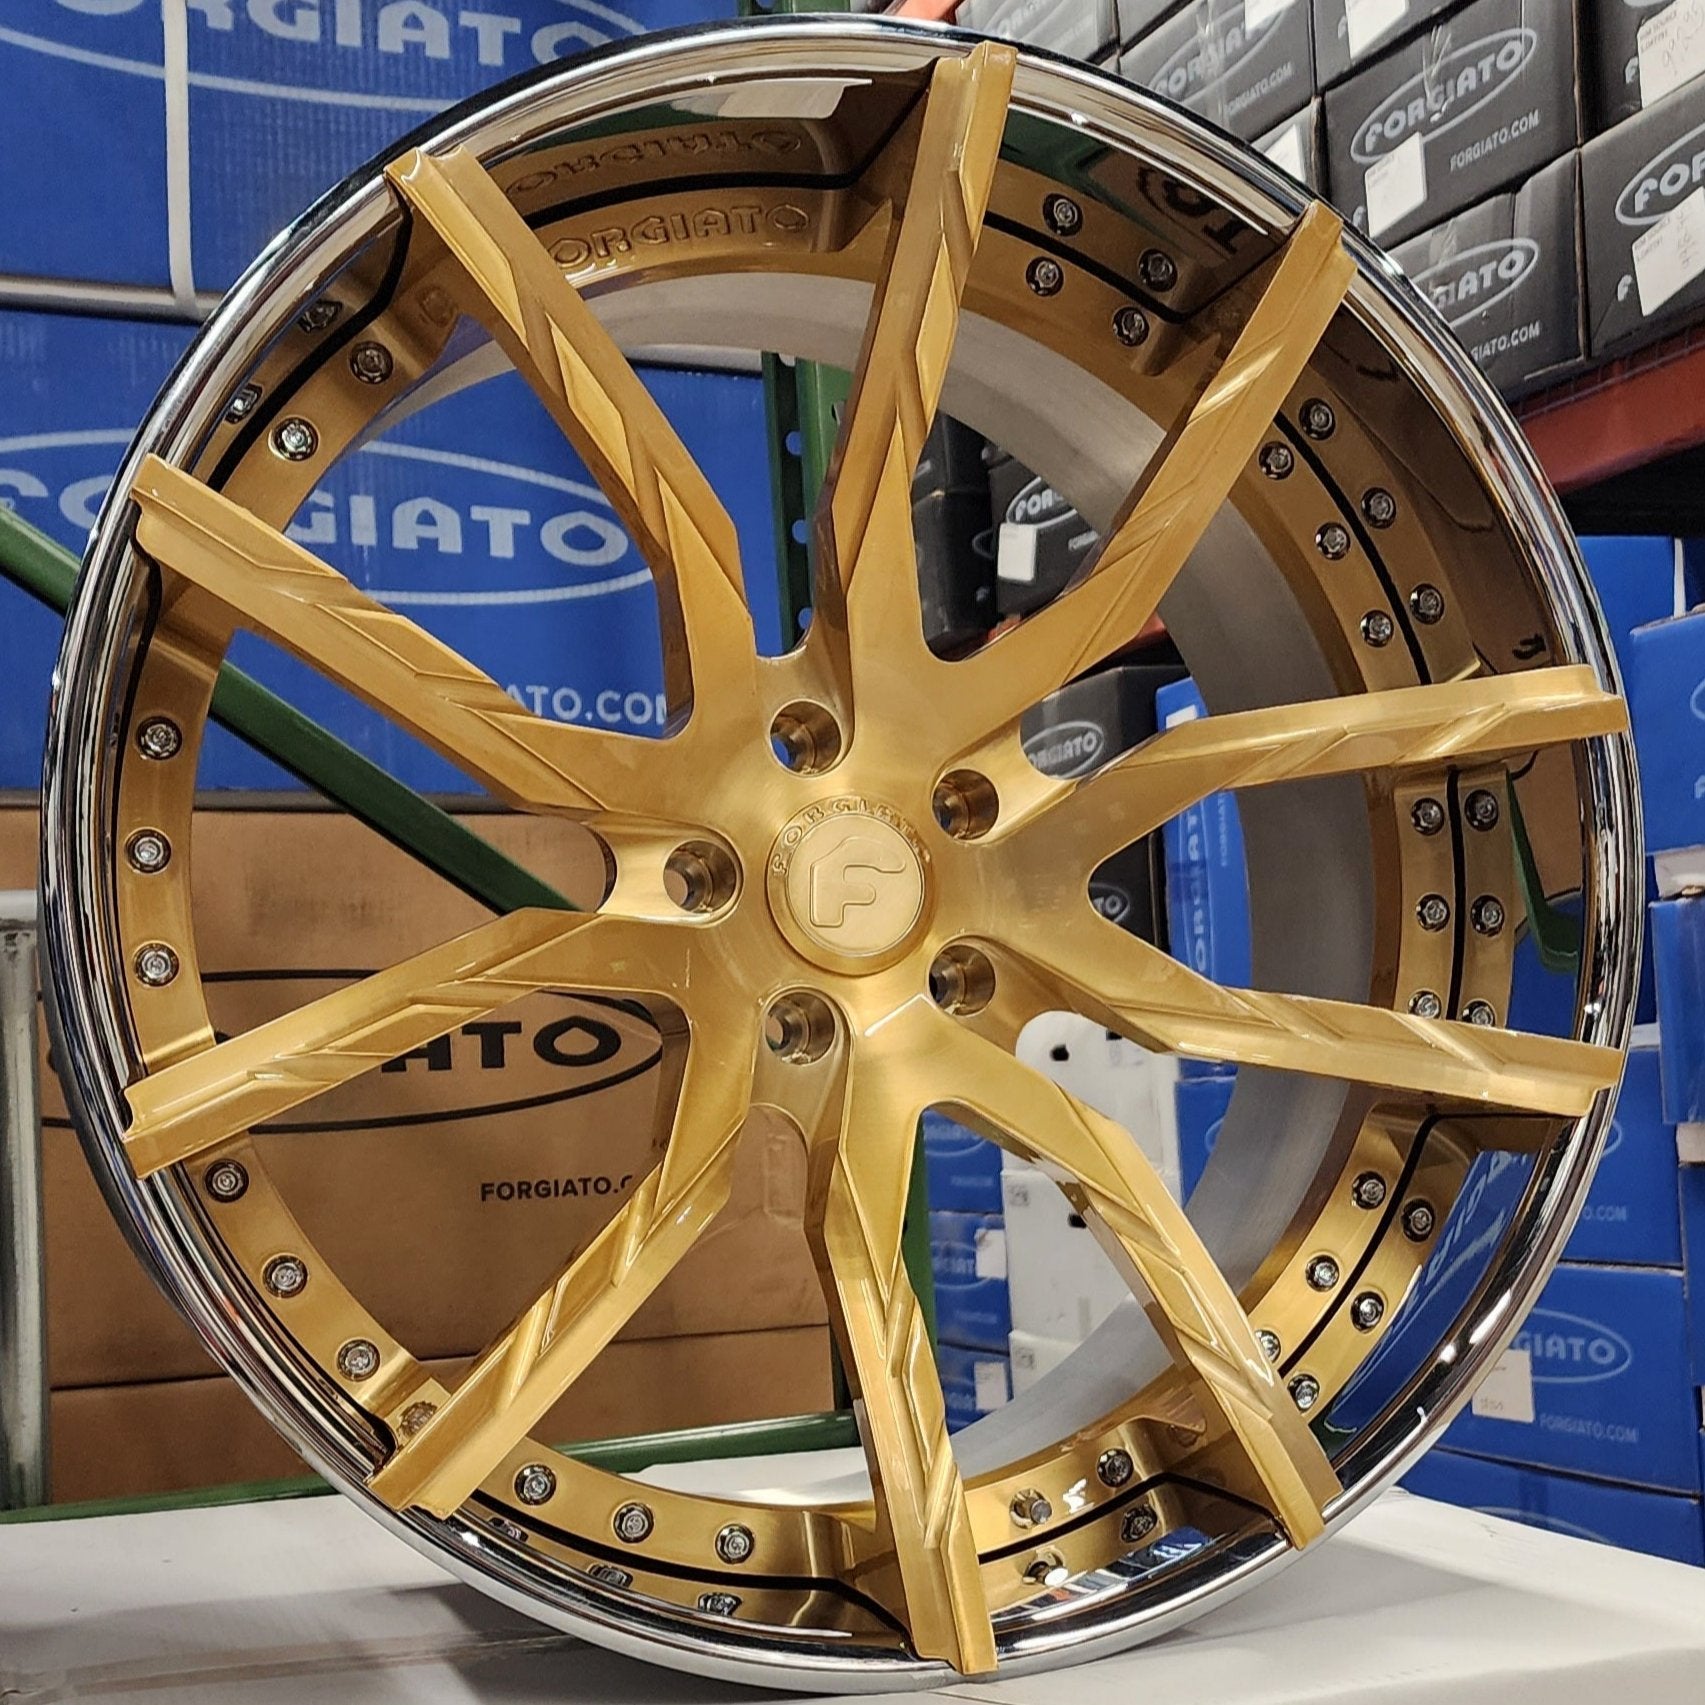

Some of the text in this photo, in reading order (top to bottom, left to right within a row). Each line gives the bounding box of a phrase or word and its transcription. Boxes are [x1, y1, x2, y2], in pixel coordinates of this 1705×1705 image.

[52, 0, 612, 66] GIATO
[1365, 40, 1524, 153] FORGIATO
[1450, 109, 1539, 171] FORGIATO.COM
[1539, 1413, 1640, 1443] FORGIATO.COM
